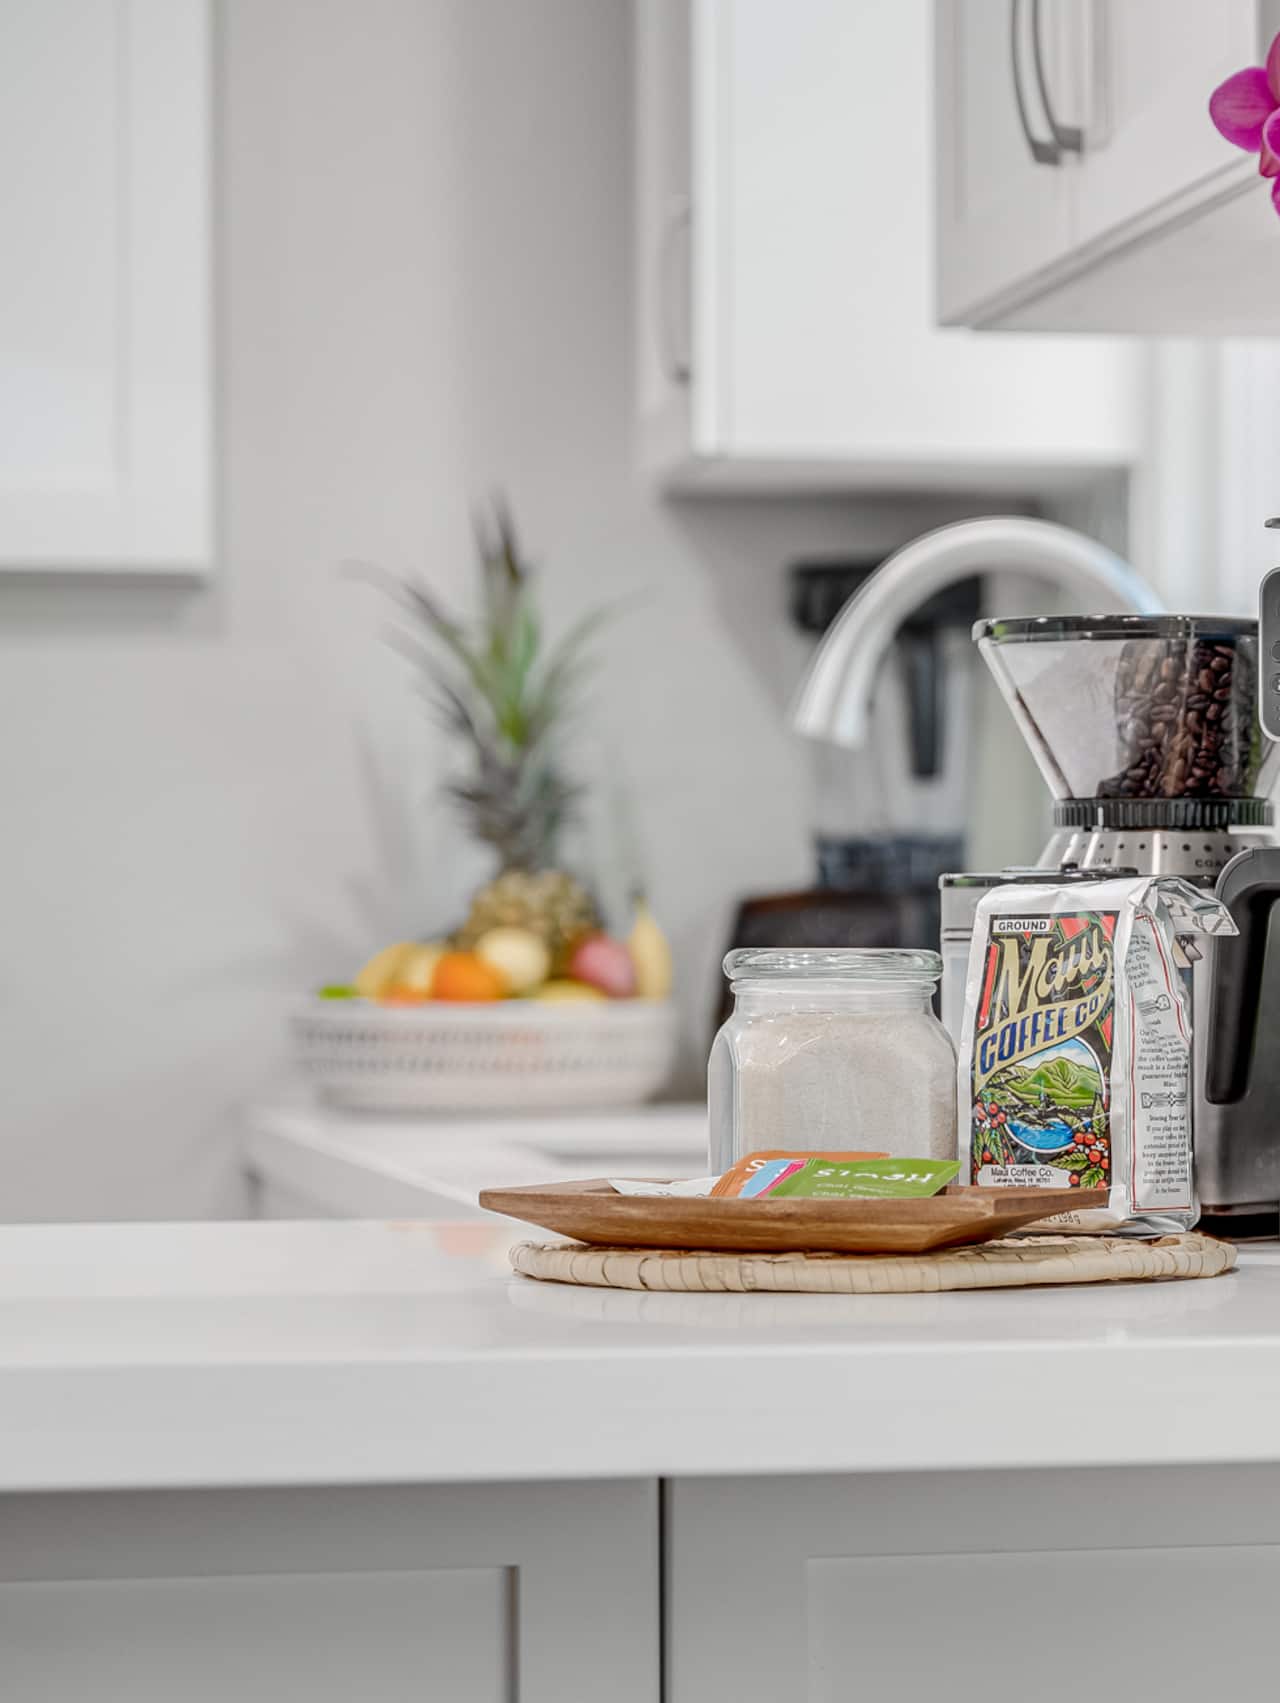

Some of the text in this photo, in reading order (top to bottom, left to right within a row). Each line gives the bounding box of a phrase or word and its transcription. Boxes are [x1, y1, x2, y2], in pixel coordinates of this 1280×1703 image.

[998, 920, 1047, 931] GROUND
[995, 928, 1105, 1021] Maui
[980, 1007, 1068, 1076] COFFEE
[1010, 1167, 1037, 1177] Coffee
[1039, 1167, 1054, 1177] Co.
